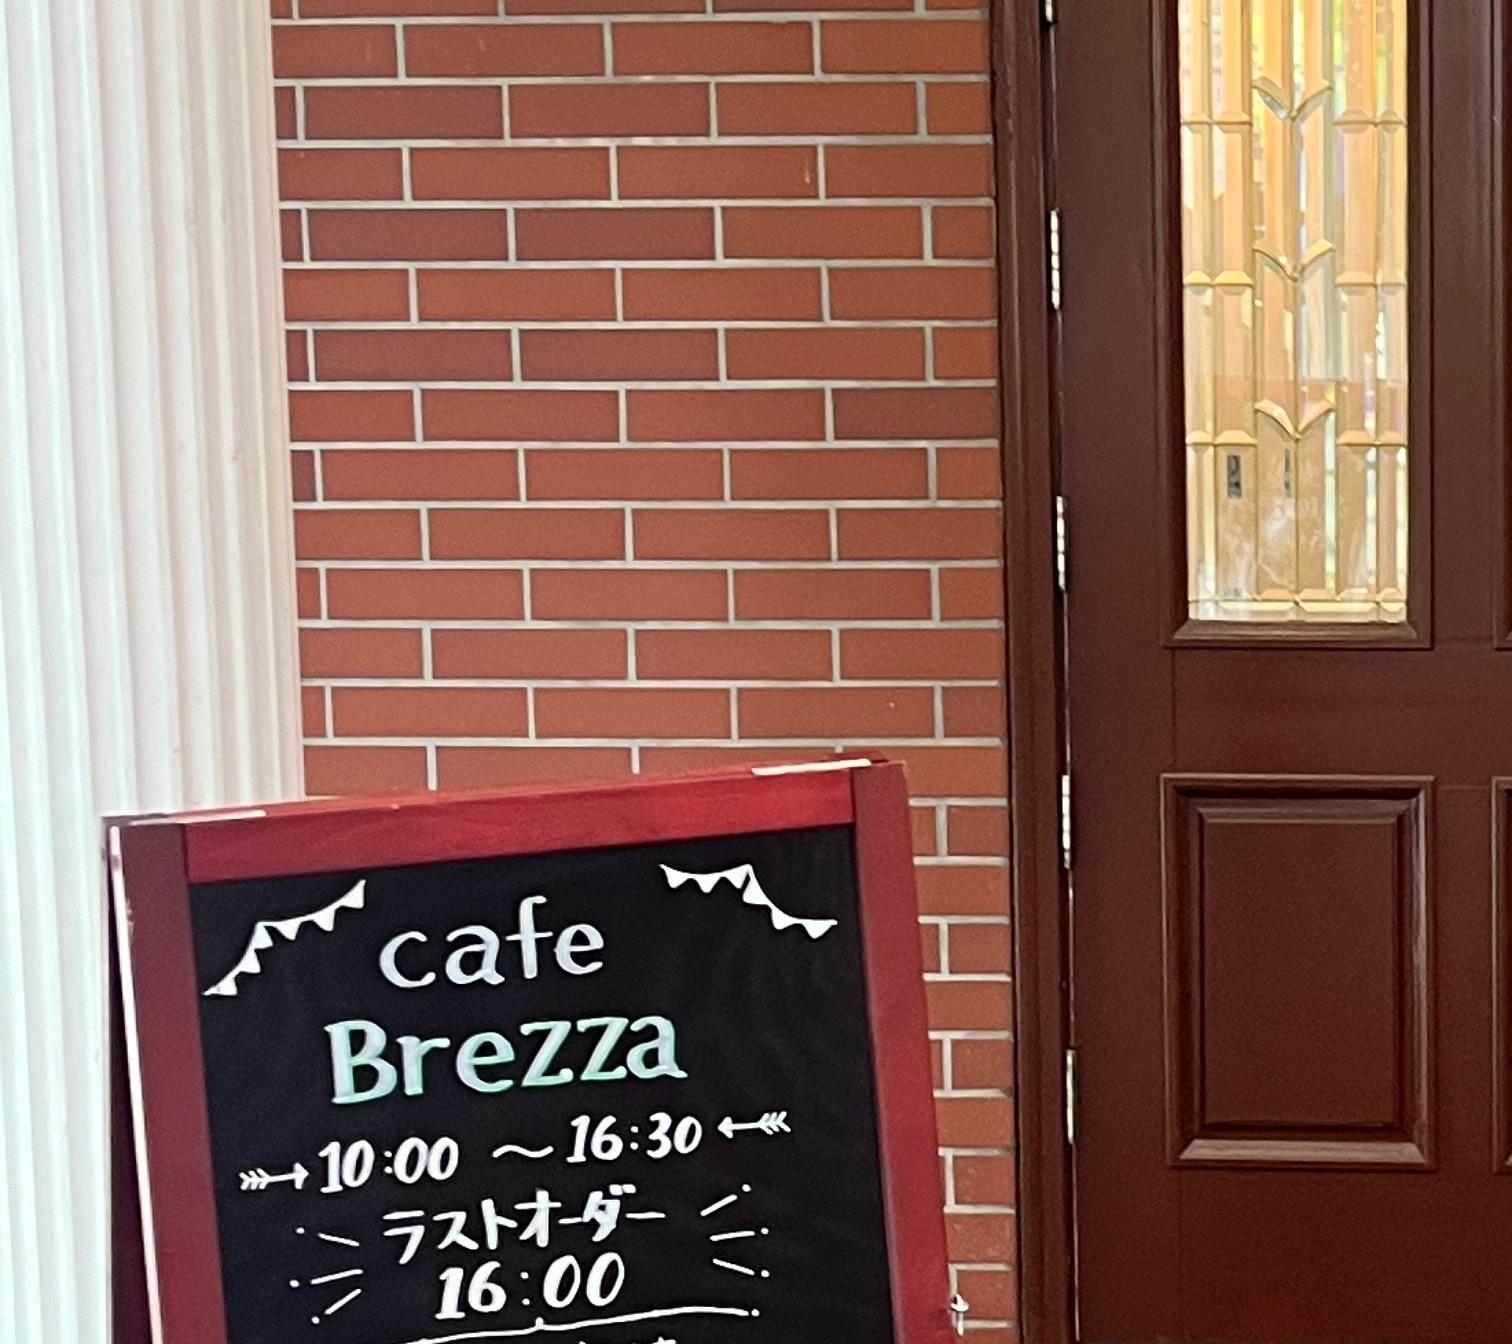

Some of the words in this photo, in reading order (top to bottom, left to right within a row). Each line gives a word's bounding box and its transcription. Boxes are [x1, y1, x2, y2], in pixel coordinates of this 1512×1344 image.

[379, 895, 604, 988] cafe
[323, 1015, 689, 1105] Brezza
[318, 1136, 460, 1194] 10:00
[382, 1183, 667, 1265] ラストオーダー
[434, 1252, 625, 1320] 16:00
